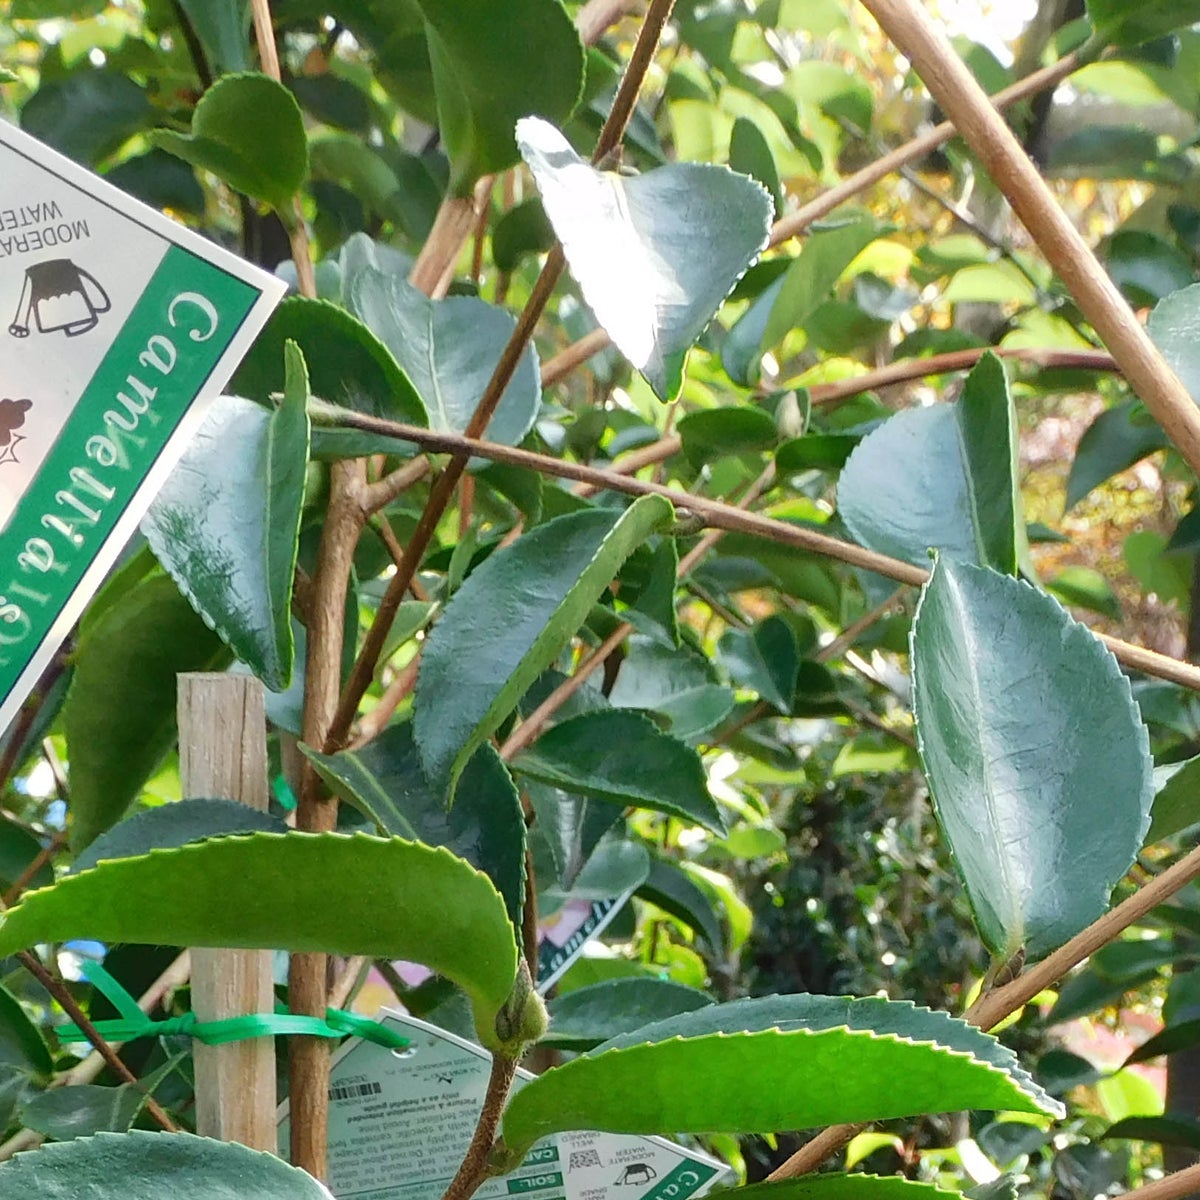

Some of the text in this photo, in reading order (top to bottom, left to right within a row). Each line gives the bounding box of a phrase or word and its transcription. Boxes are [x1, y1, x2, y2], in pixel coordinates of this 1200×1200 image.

[0, 219, 90, 258] MODERA
[18, 291, 218, 573] Camellia
[569, 1138, 594, 1148] WELL
[524, 1147, 553, 1161] CAR
[614, 1145, 645, 1156] WATER
[518, 1174, 556, 1188] SOIL:
